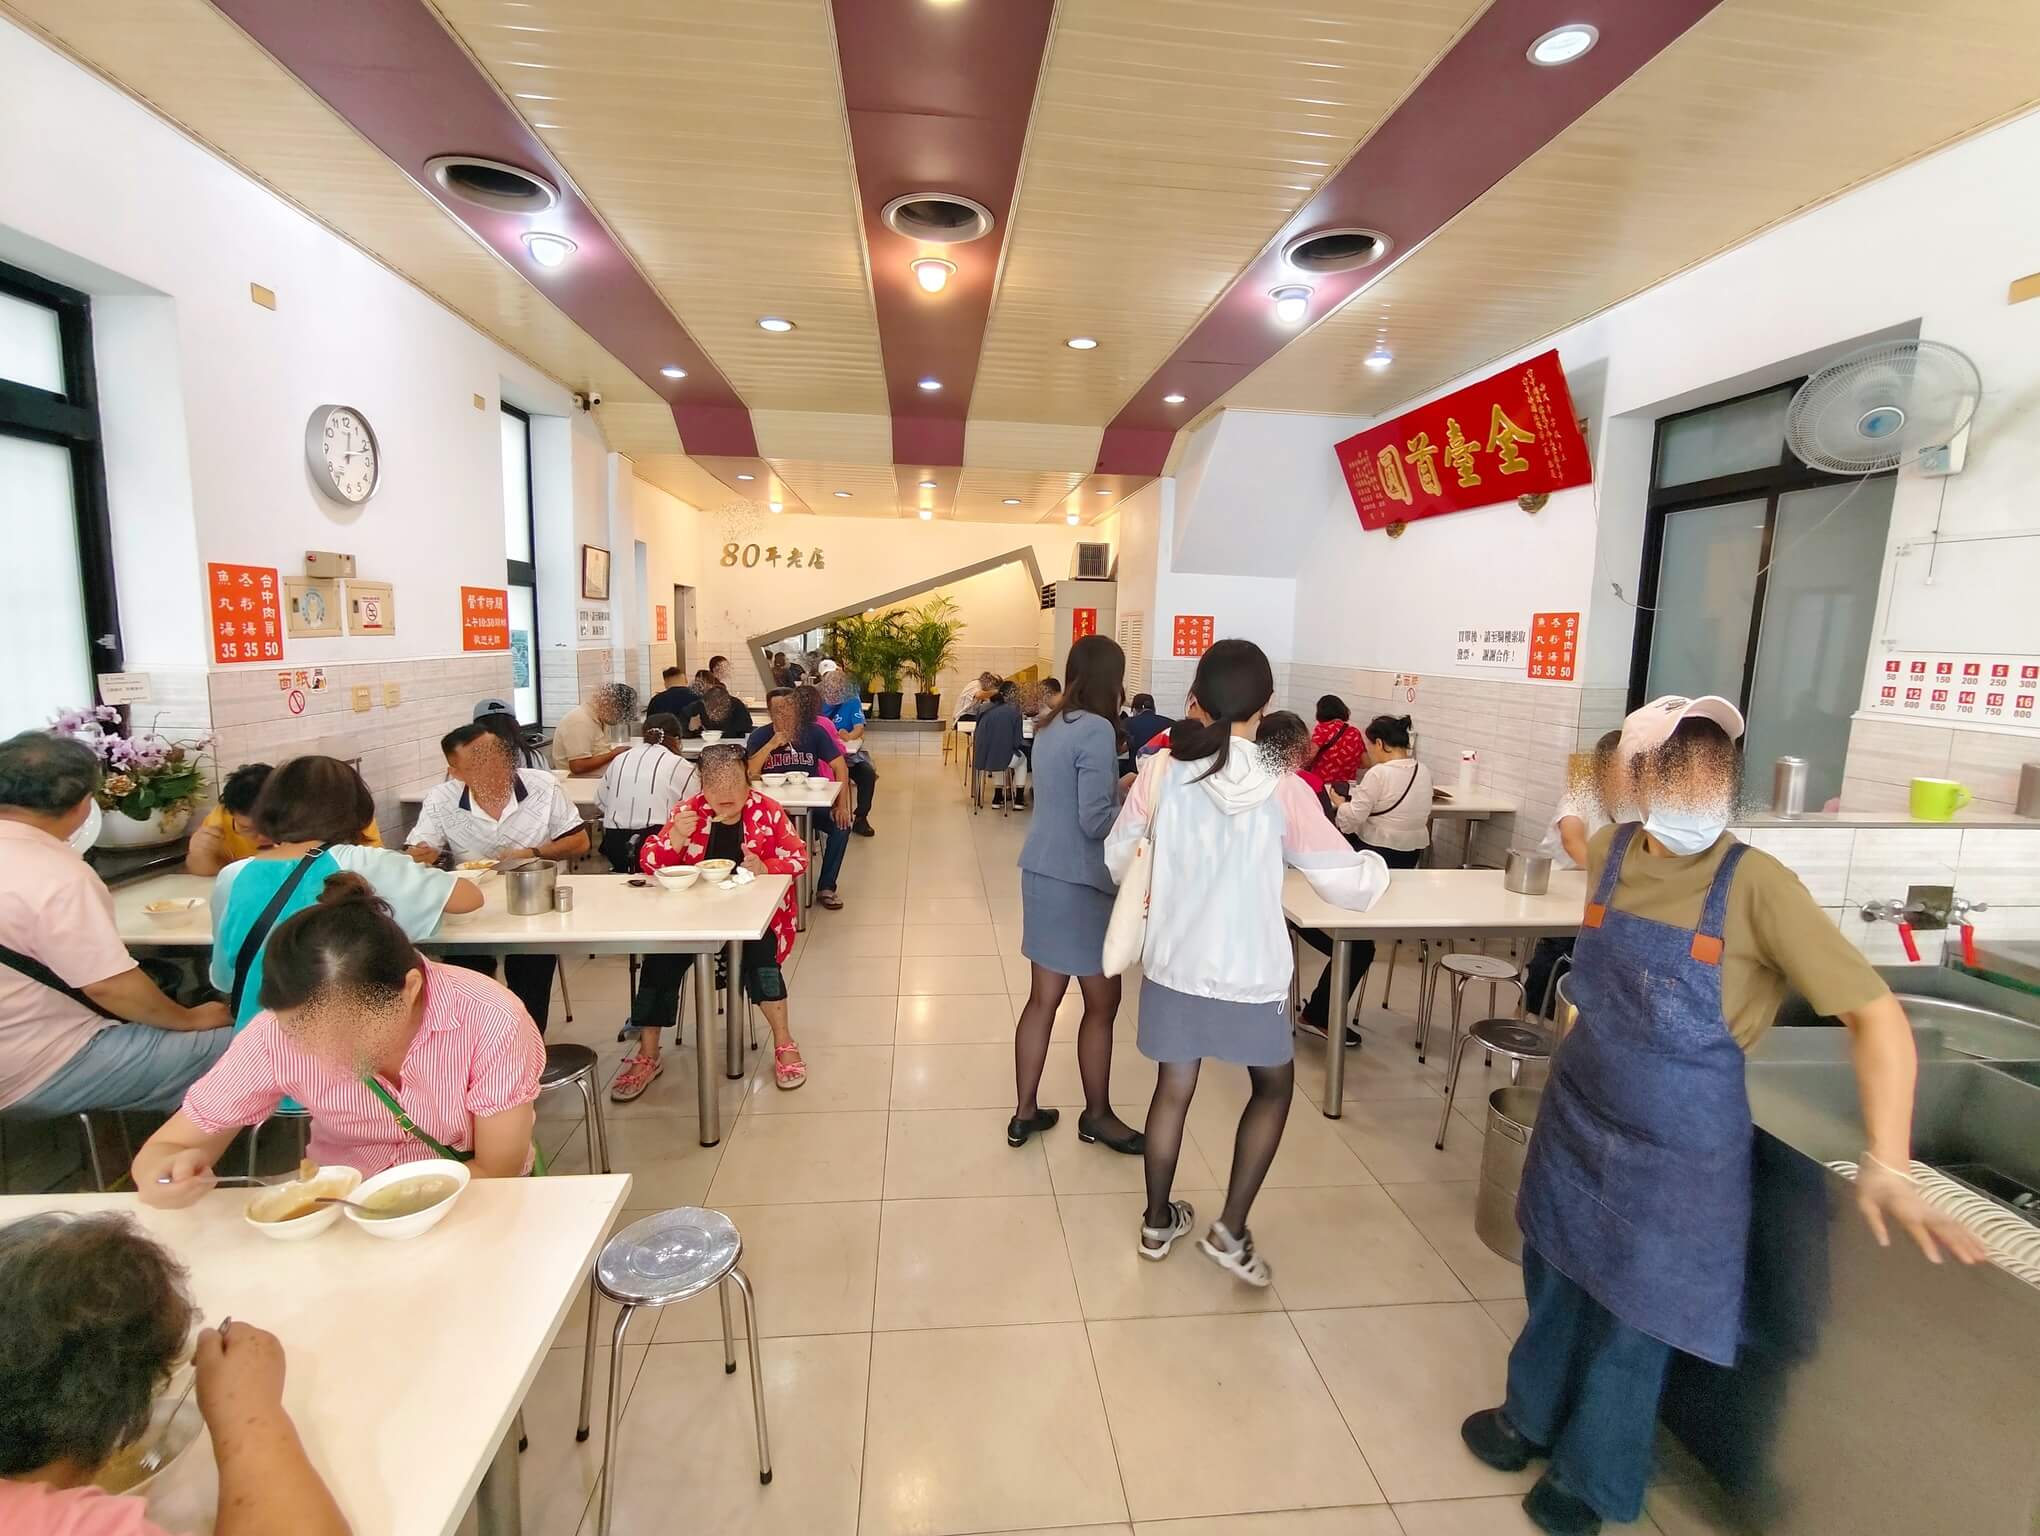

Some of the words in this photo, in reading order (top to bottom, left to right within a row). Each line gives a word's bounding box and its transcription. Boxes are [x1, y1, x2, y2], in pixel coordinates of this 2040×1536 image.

[221, 642, 237, 658] 35
[244, 642, 258, 657] 35
[265, 641, 279, 656] 50
[1532, 665, 1542, 676] 35
[1546, 666, 1556, 676] 35
[1560, 667, 1571, 677] 50
[1989, 679, 2007, 687] 250
[1883, 688, 1893, 696] 11
[1908, 689, 1919, 699] 12
[1934, 691, 1945, 701] 13
[1961, 693, 1973, 703] 14
[1989, 695, 2001, 705] 15
[2018, 697, 2031, 707] 16
[1957, 705, 1973, 713] 700
[1985, 707, 2002, 716] 750
